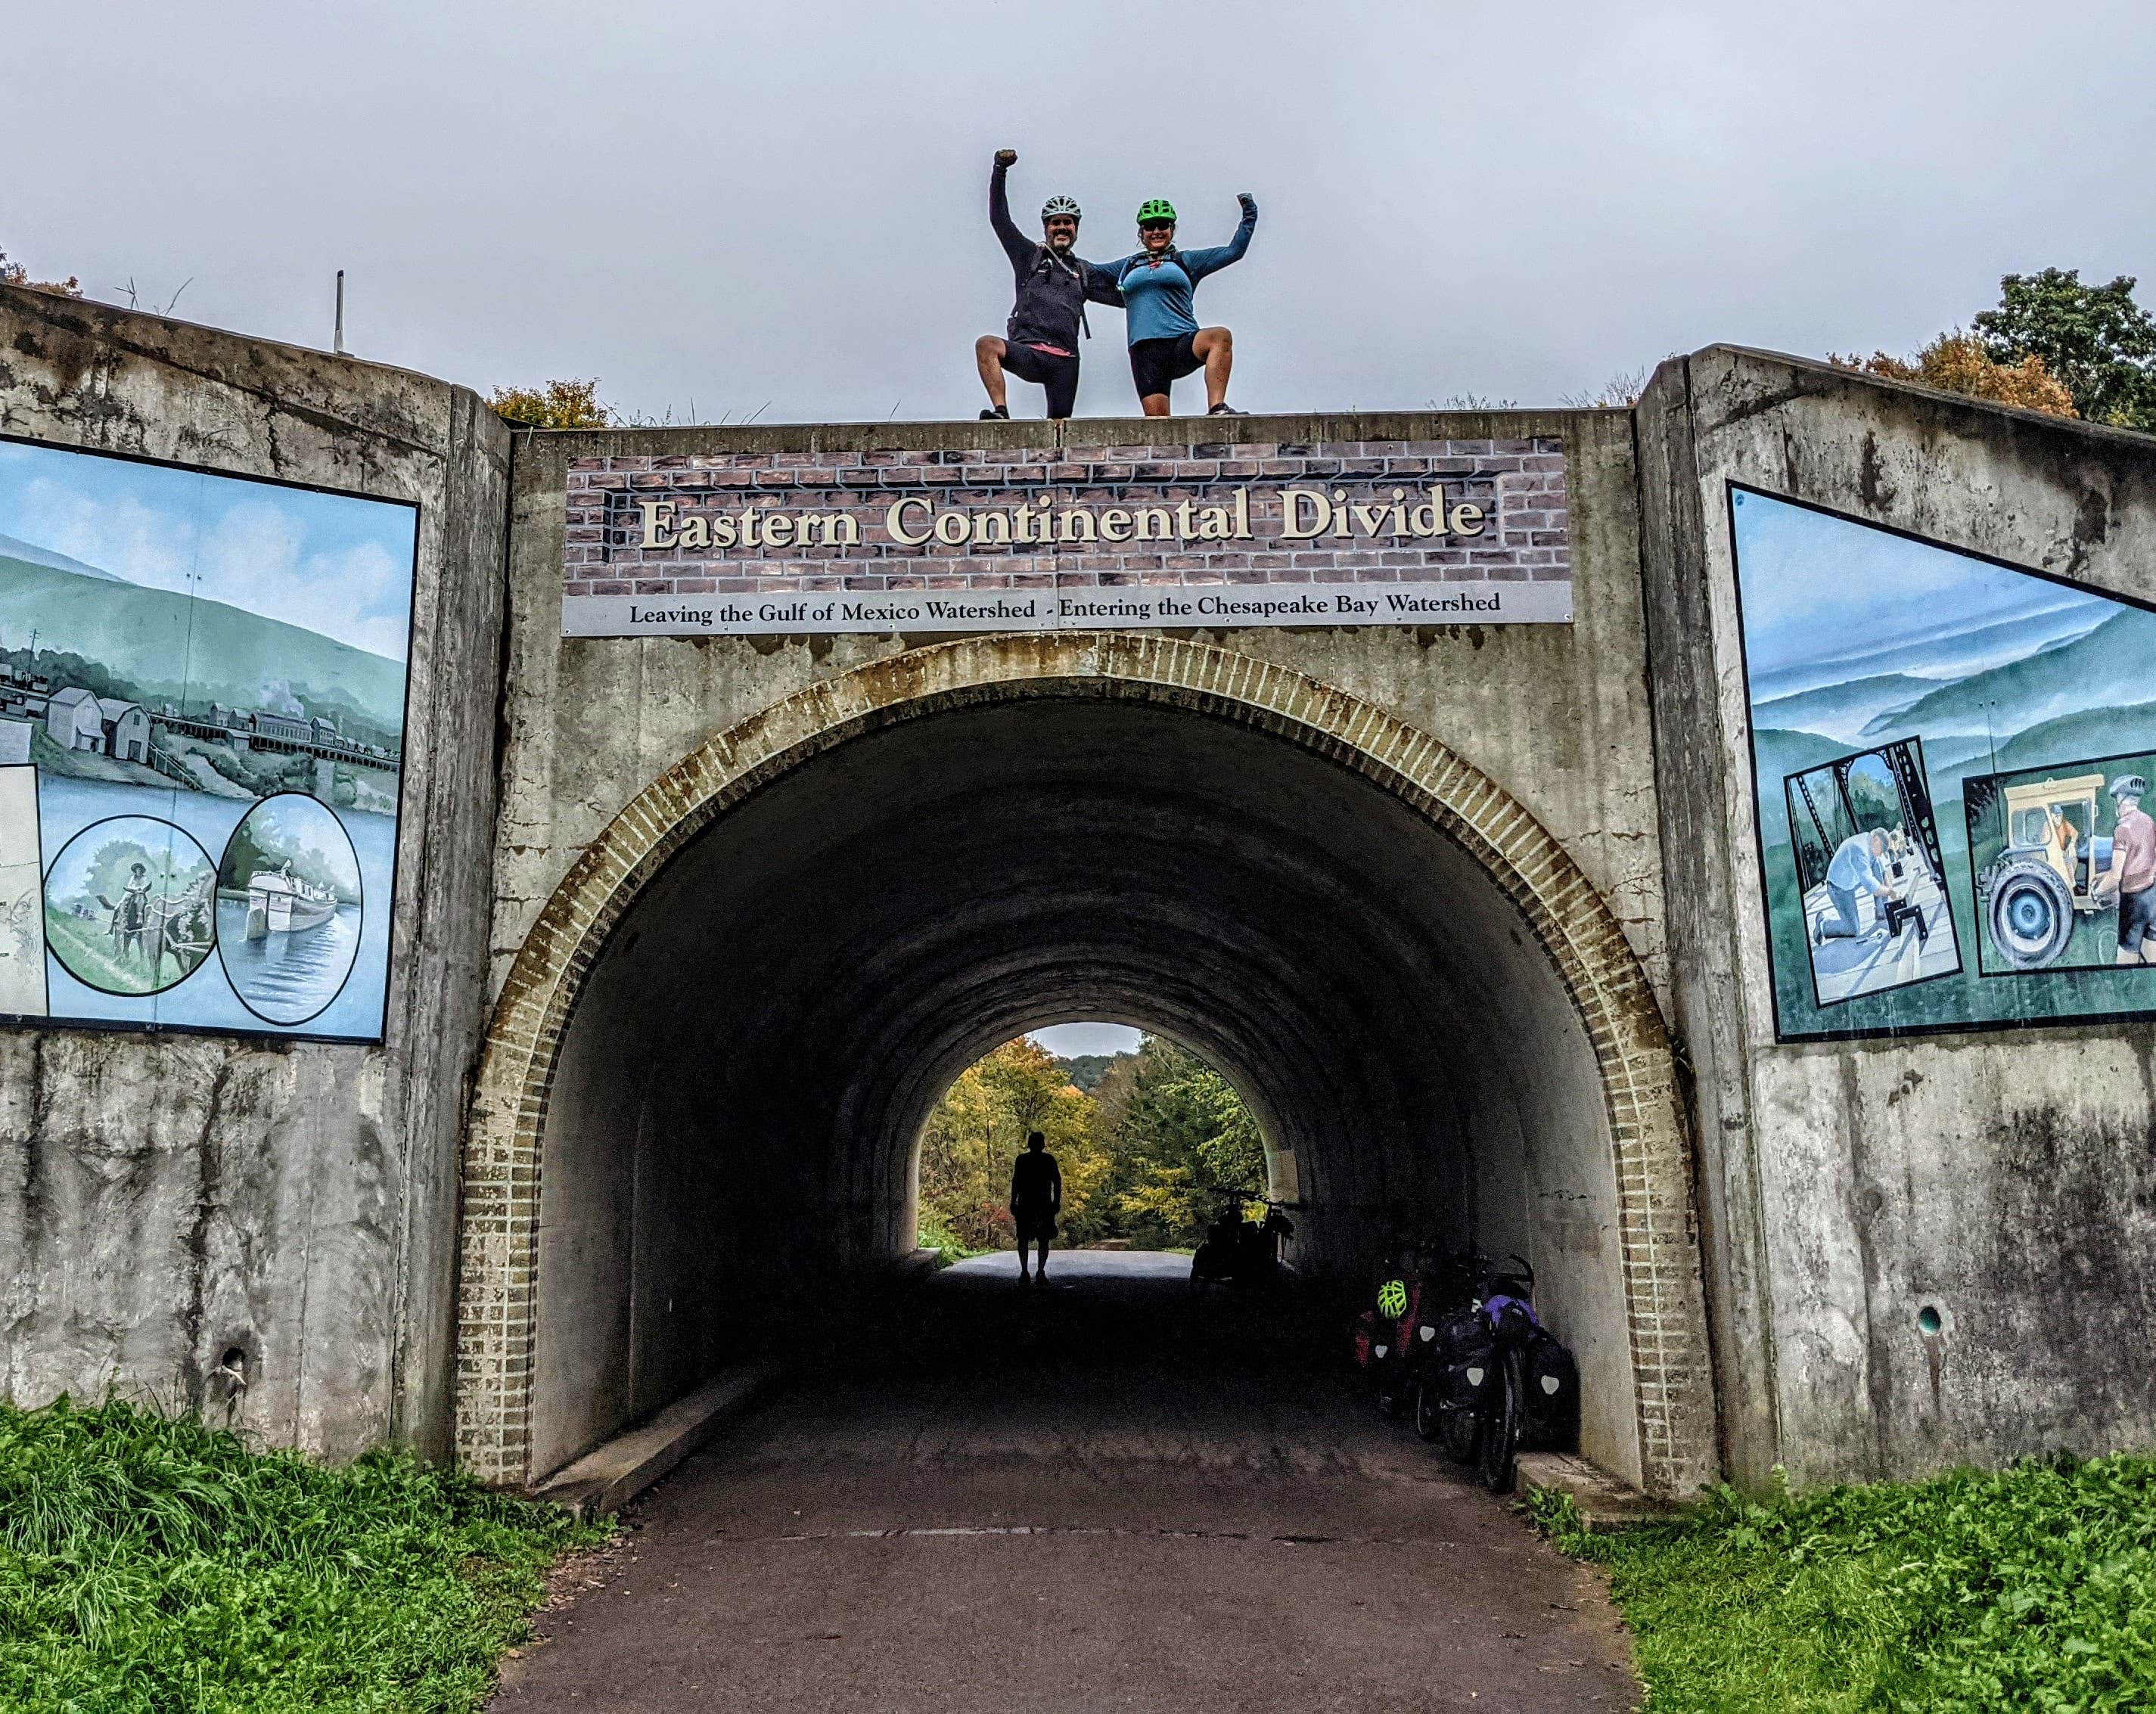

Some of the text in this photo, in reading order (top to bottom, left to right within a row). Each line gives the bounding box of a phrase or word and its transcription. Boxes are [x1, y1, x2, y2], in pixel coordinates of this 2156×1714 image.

[638, 484, 1486, 550] Eastern Continental Divide
[630, 605, 713, 626] Leaving
[720, 604, 753, 622] the
[759, 603, 807, 622] Gulf
[812, 603, 836, 621] of
[841, 602, 919, 621] Mexico
[926, 599, 1036, 619] Watershed
[1059, 598, 1151, 619] Entering
[1157, 598, 1192, 616] the
[1198, 596, 1328, 617] Chesapeake
[1335, 596, 1379, 617] Bay
[1386, 593, 1501, 613] Watershed
